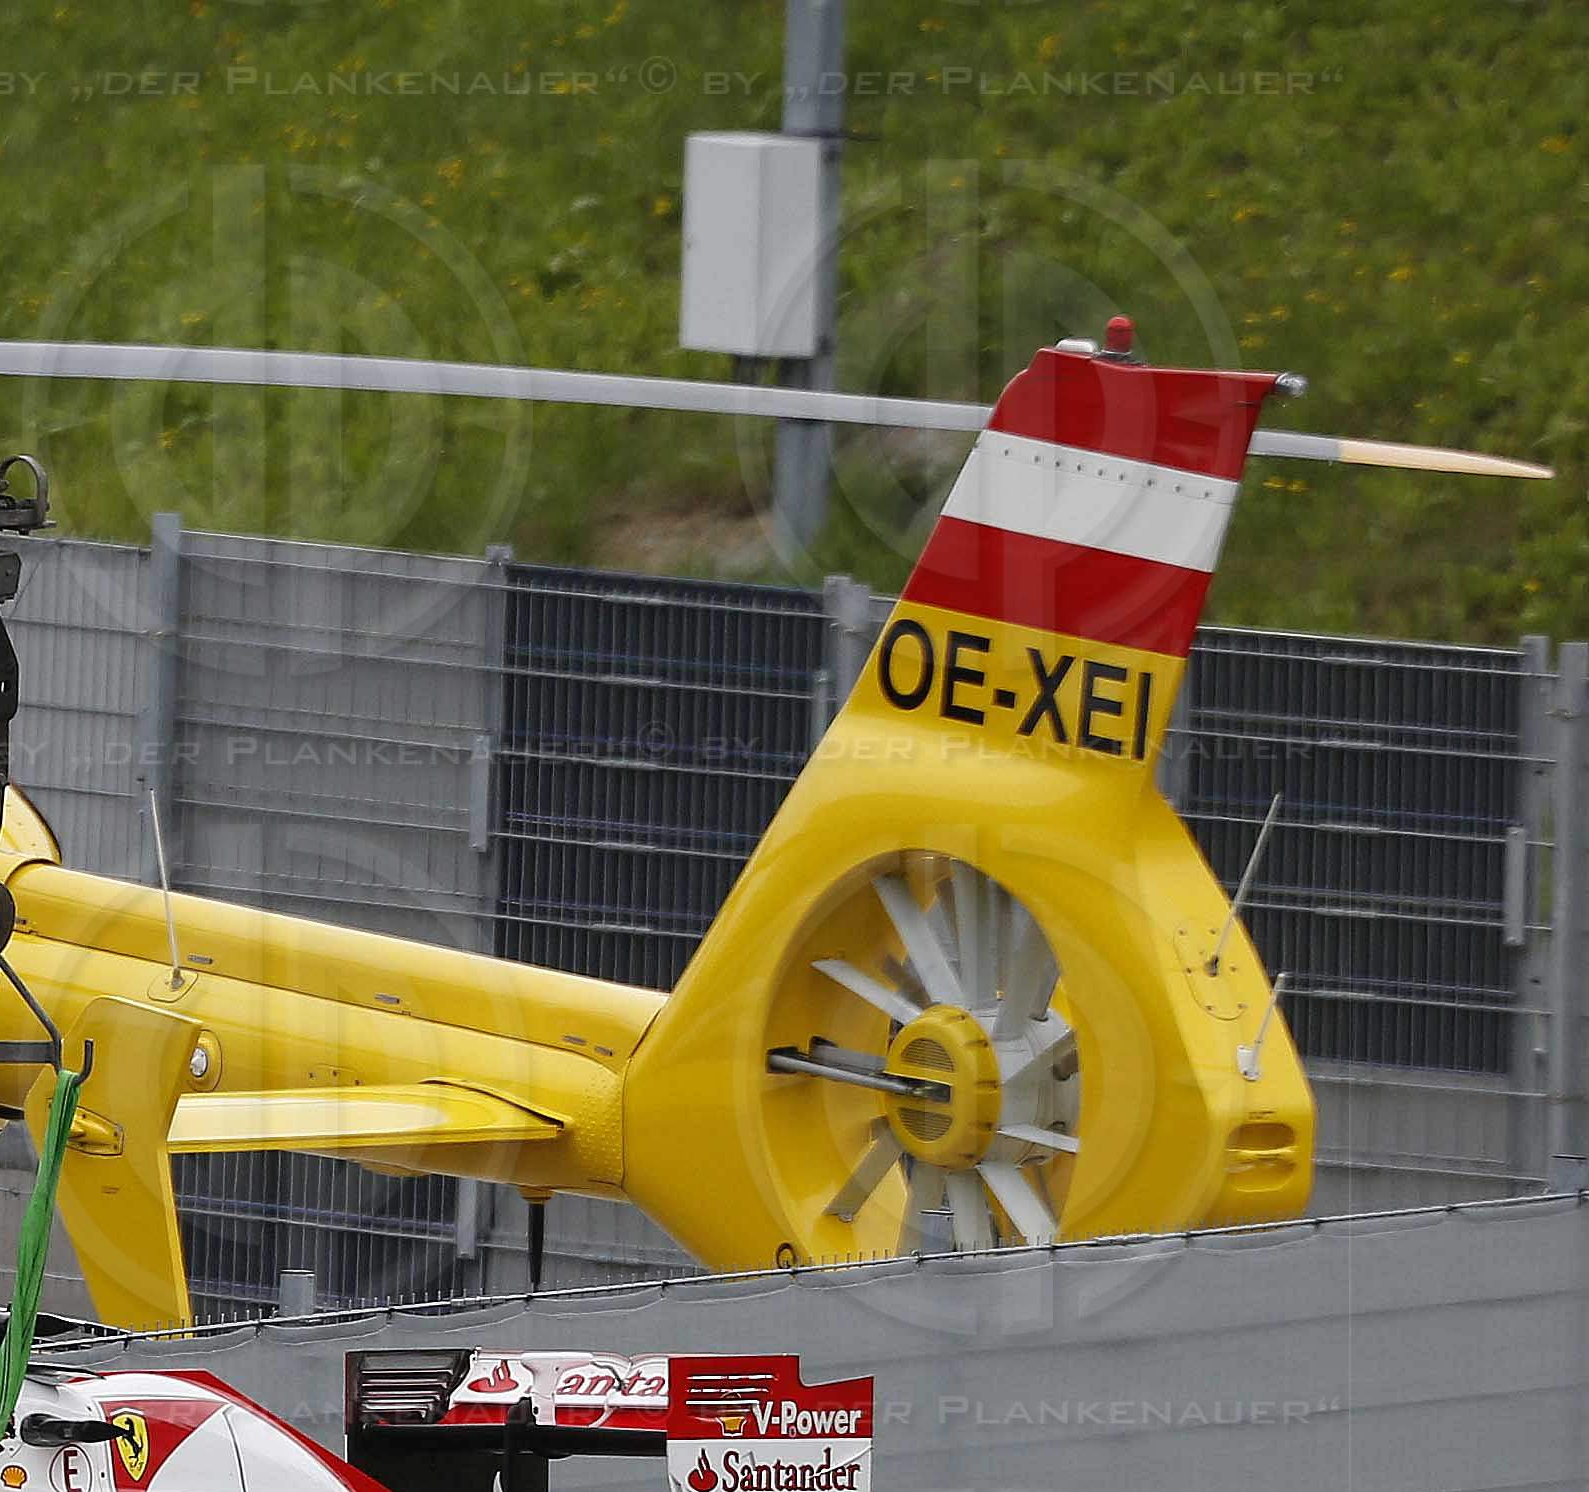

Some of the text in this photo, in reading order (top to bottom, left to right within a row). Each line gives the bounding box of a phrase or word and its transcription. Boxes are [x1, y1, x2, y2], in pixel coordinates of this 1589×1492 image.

[878, 618, 1152, 760] OE-XEI
[756, 1401, 862, 1436] V-Power
[723, 1446, 861, 1492] Santander
